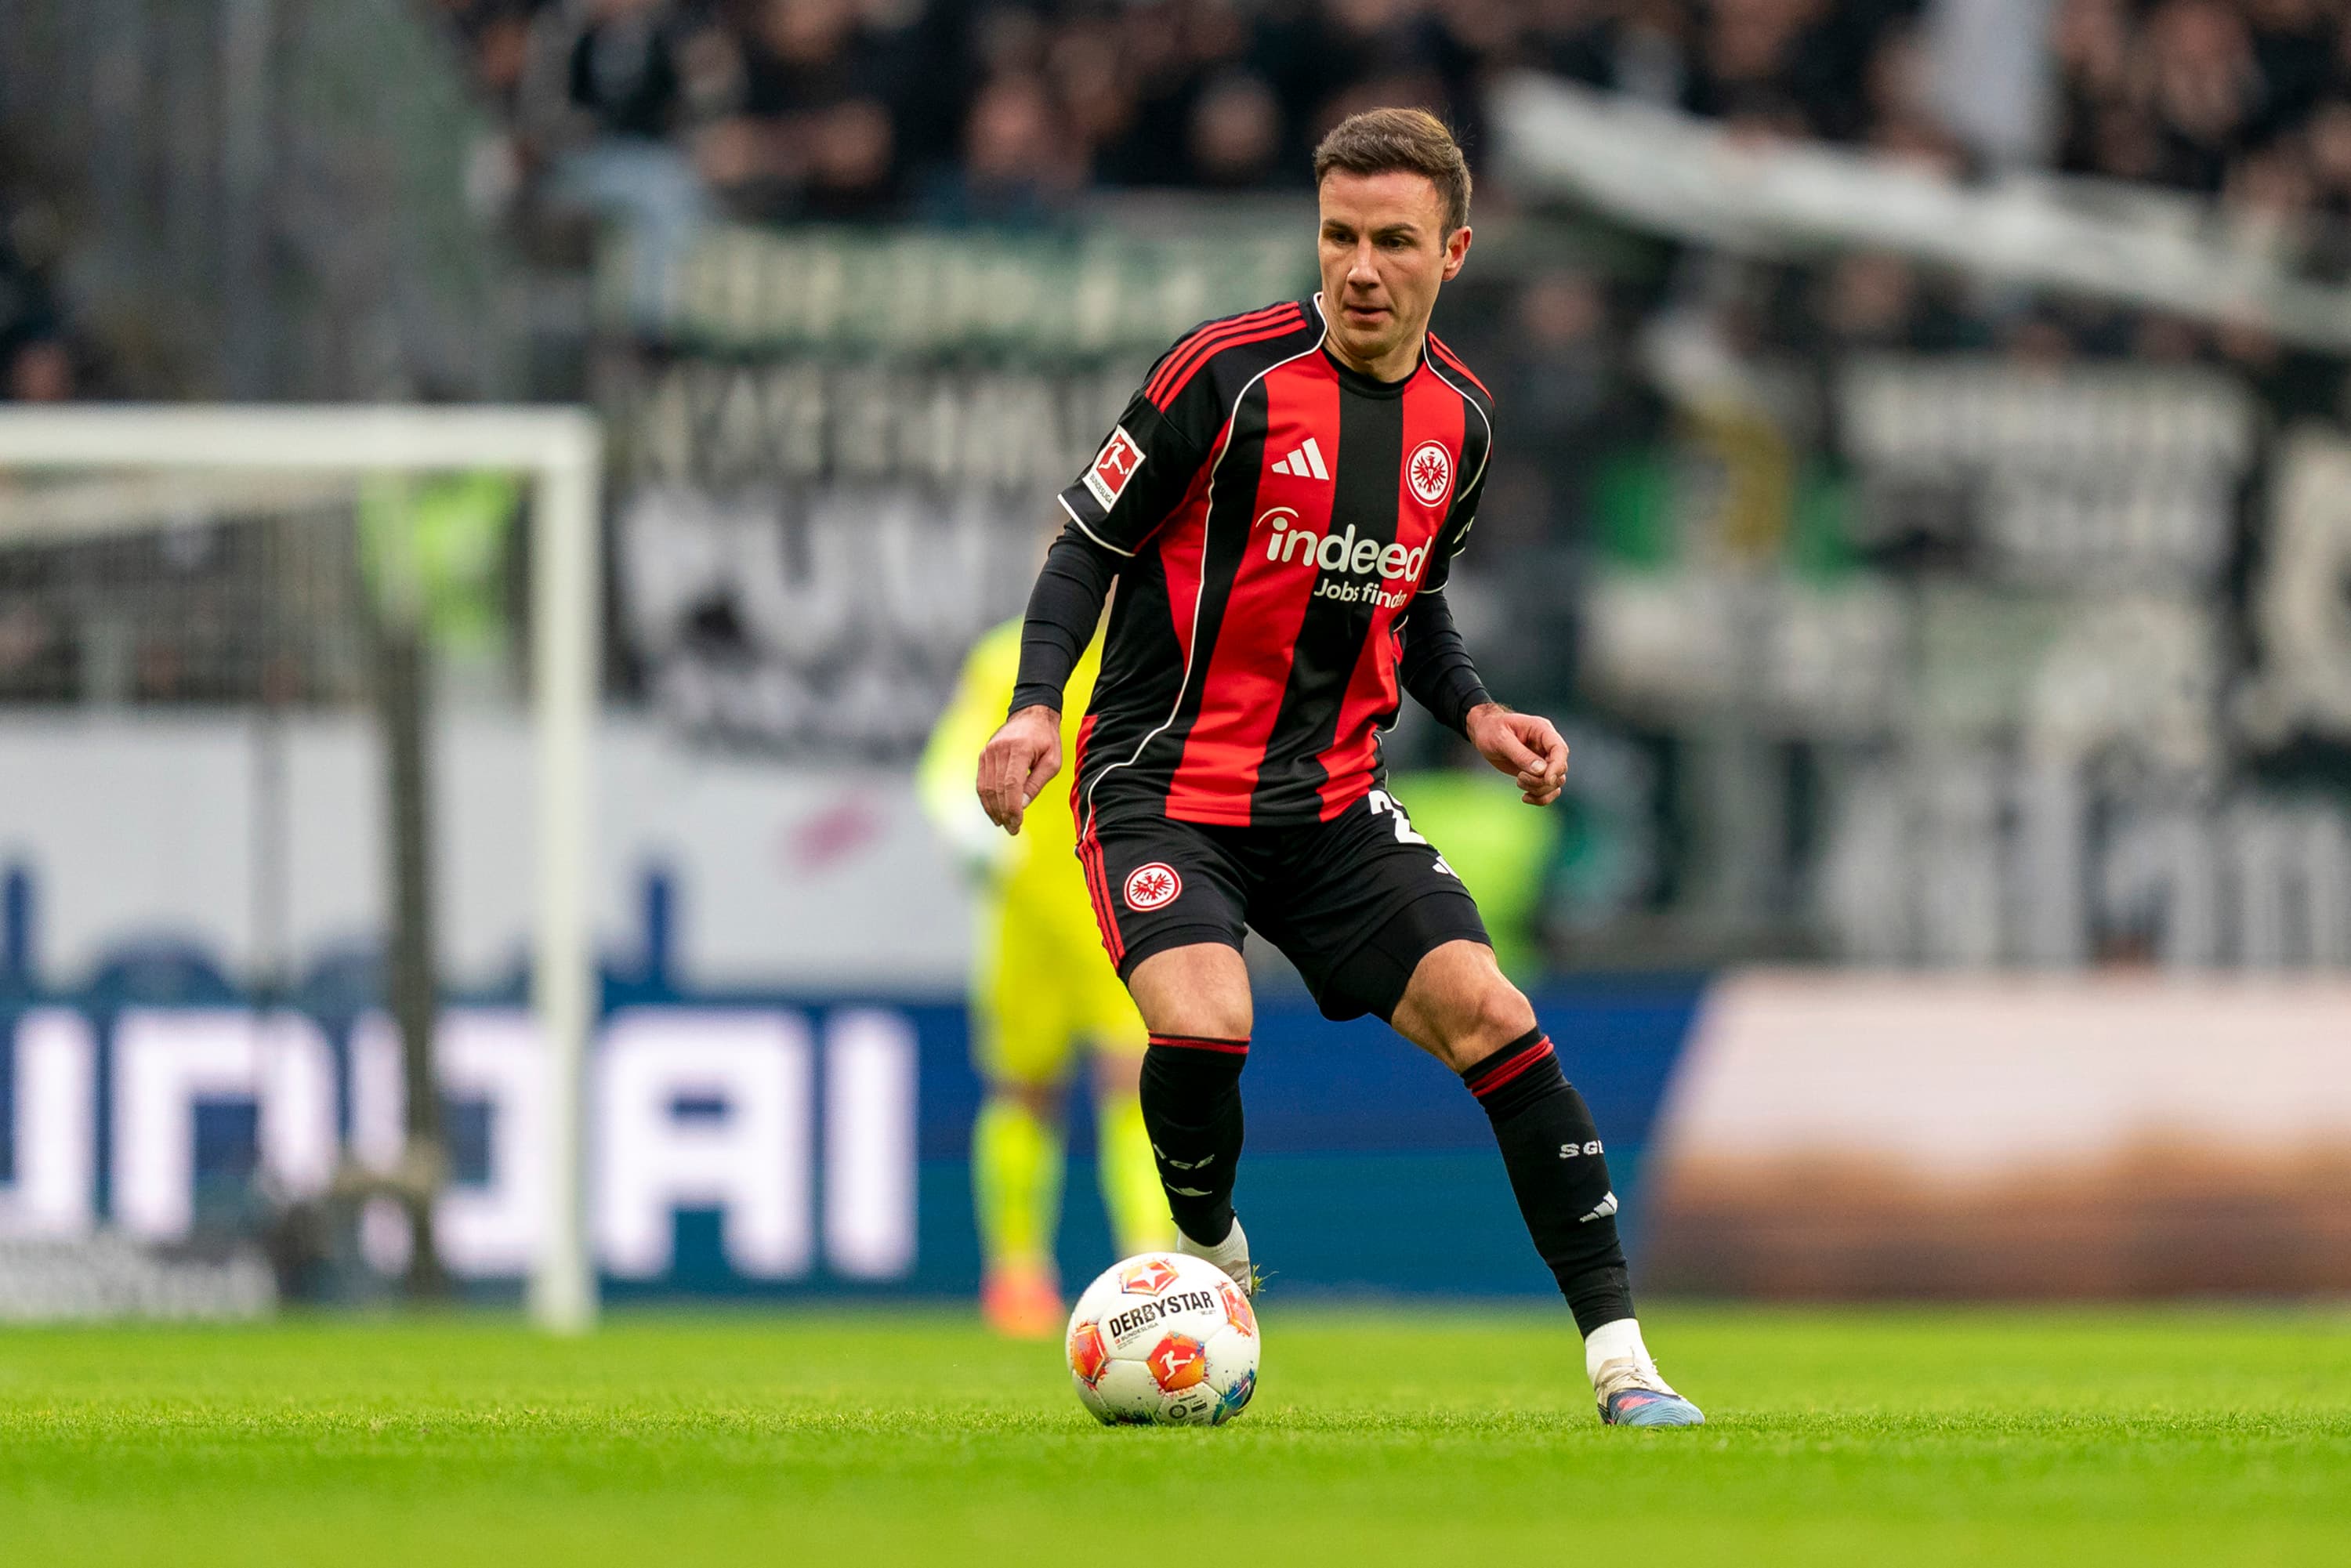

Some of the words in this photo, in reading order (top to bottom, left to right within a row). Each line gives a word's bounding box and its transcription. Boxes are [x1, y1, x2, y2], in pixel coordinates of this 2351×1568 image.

[1089, 473, 1113, 504] BUNDESLIGA
[1265, 516, 1433, 582] indeed
[1313, 578, 1360, 603] Jobs
[1109, 1291, 1215, 1338] DERBYSTAR
